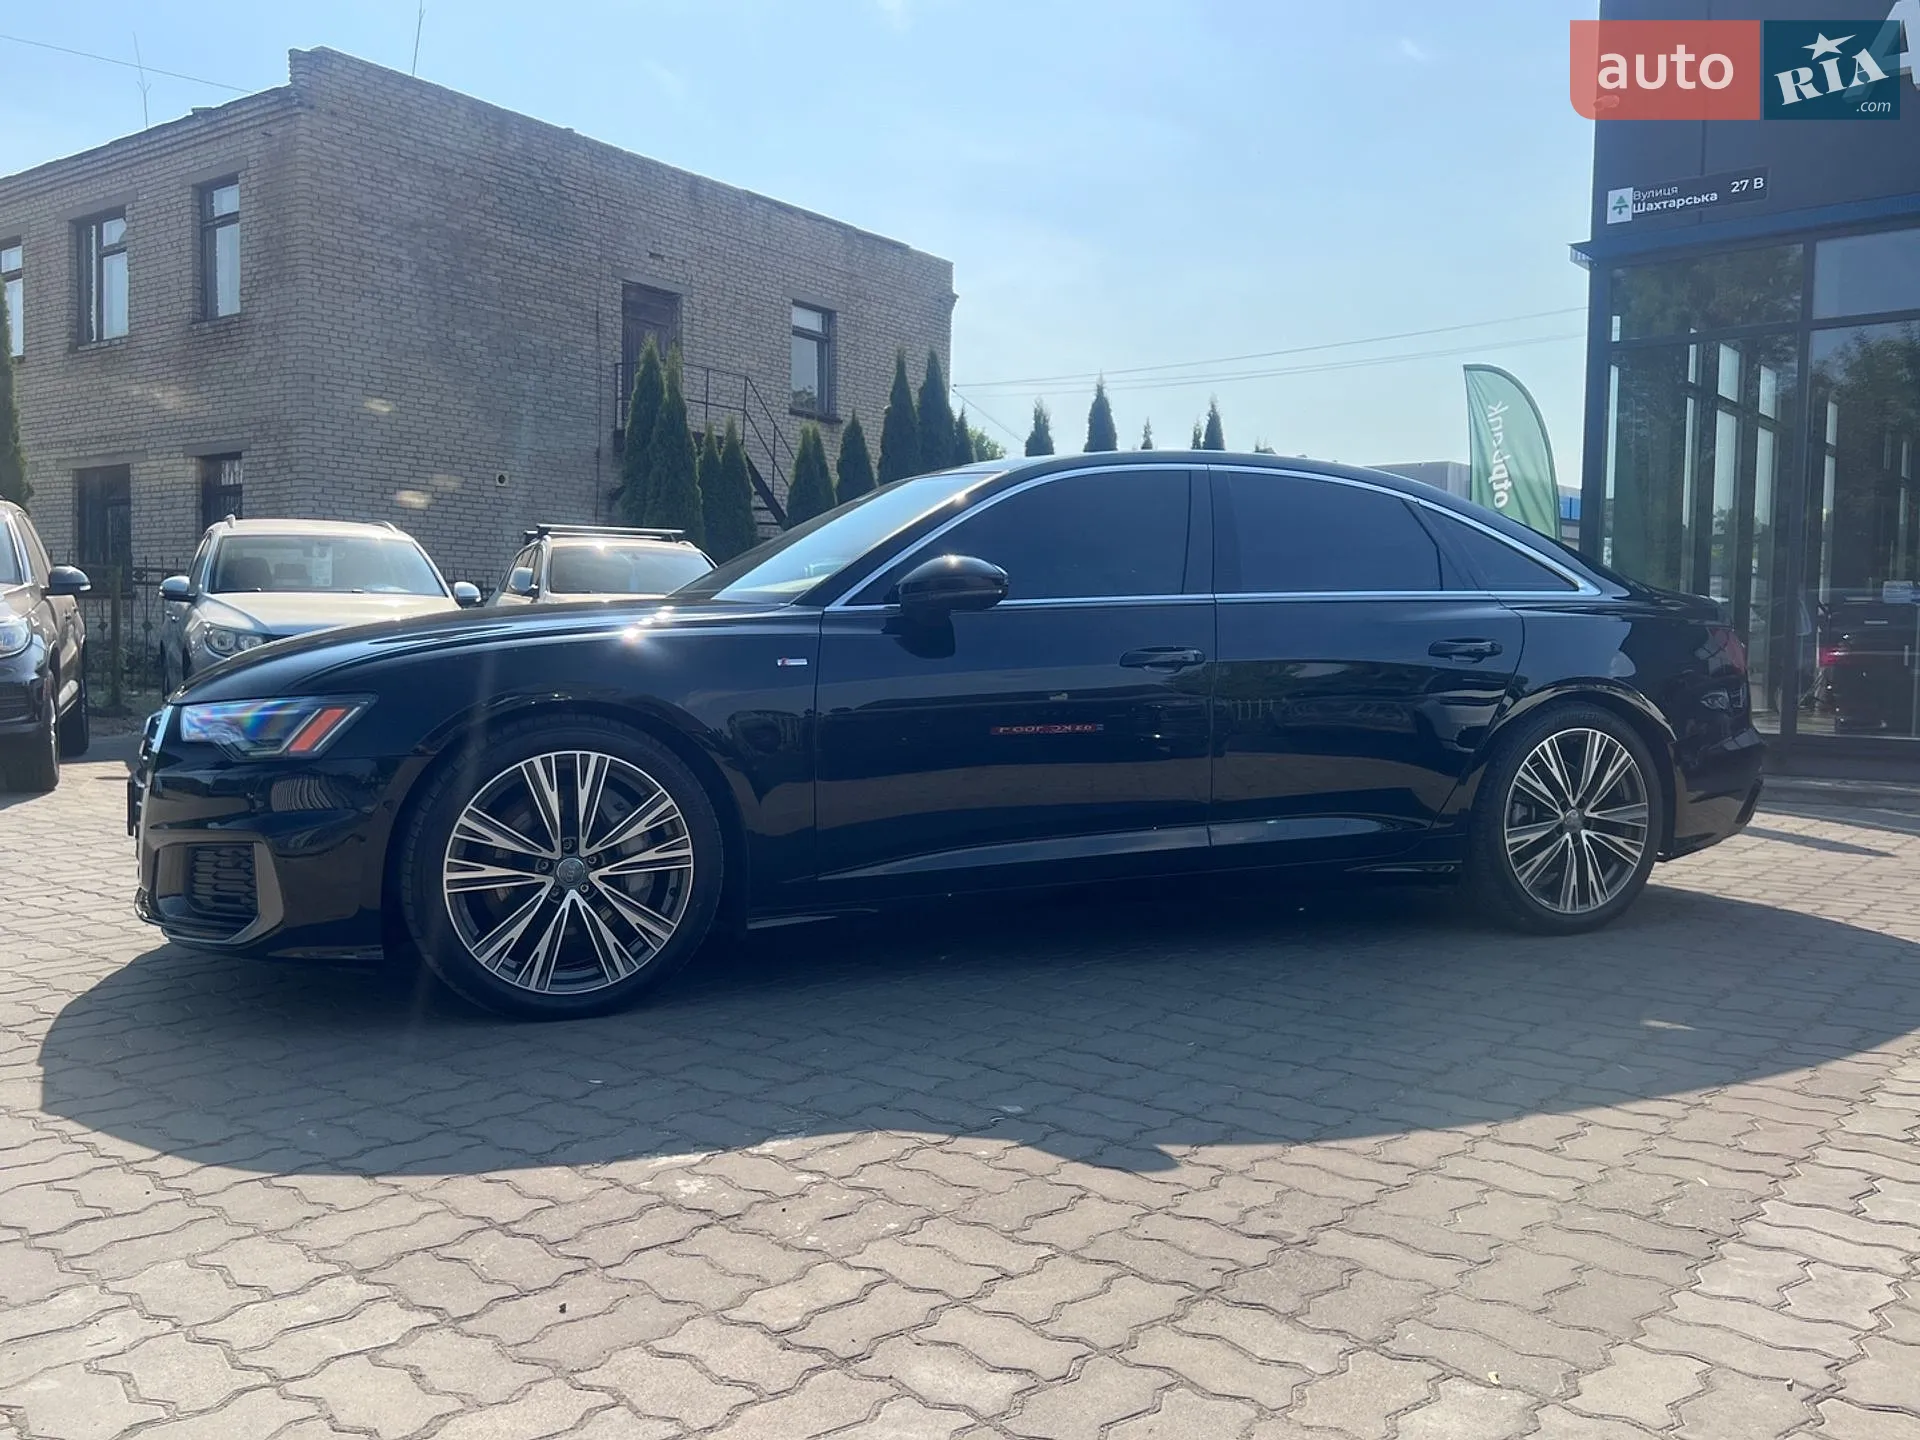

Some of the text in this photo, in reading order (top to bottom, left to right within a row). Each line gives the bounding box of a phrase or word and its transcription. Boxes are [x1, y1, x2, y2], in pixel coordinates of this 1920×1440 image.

[1633, 185, 1679, 201] Вулиця
[1730, 179, 1749, 193] 27
[1633, 191, 1718, 214] Шахтарська
